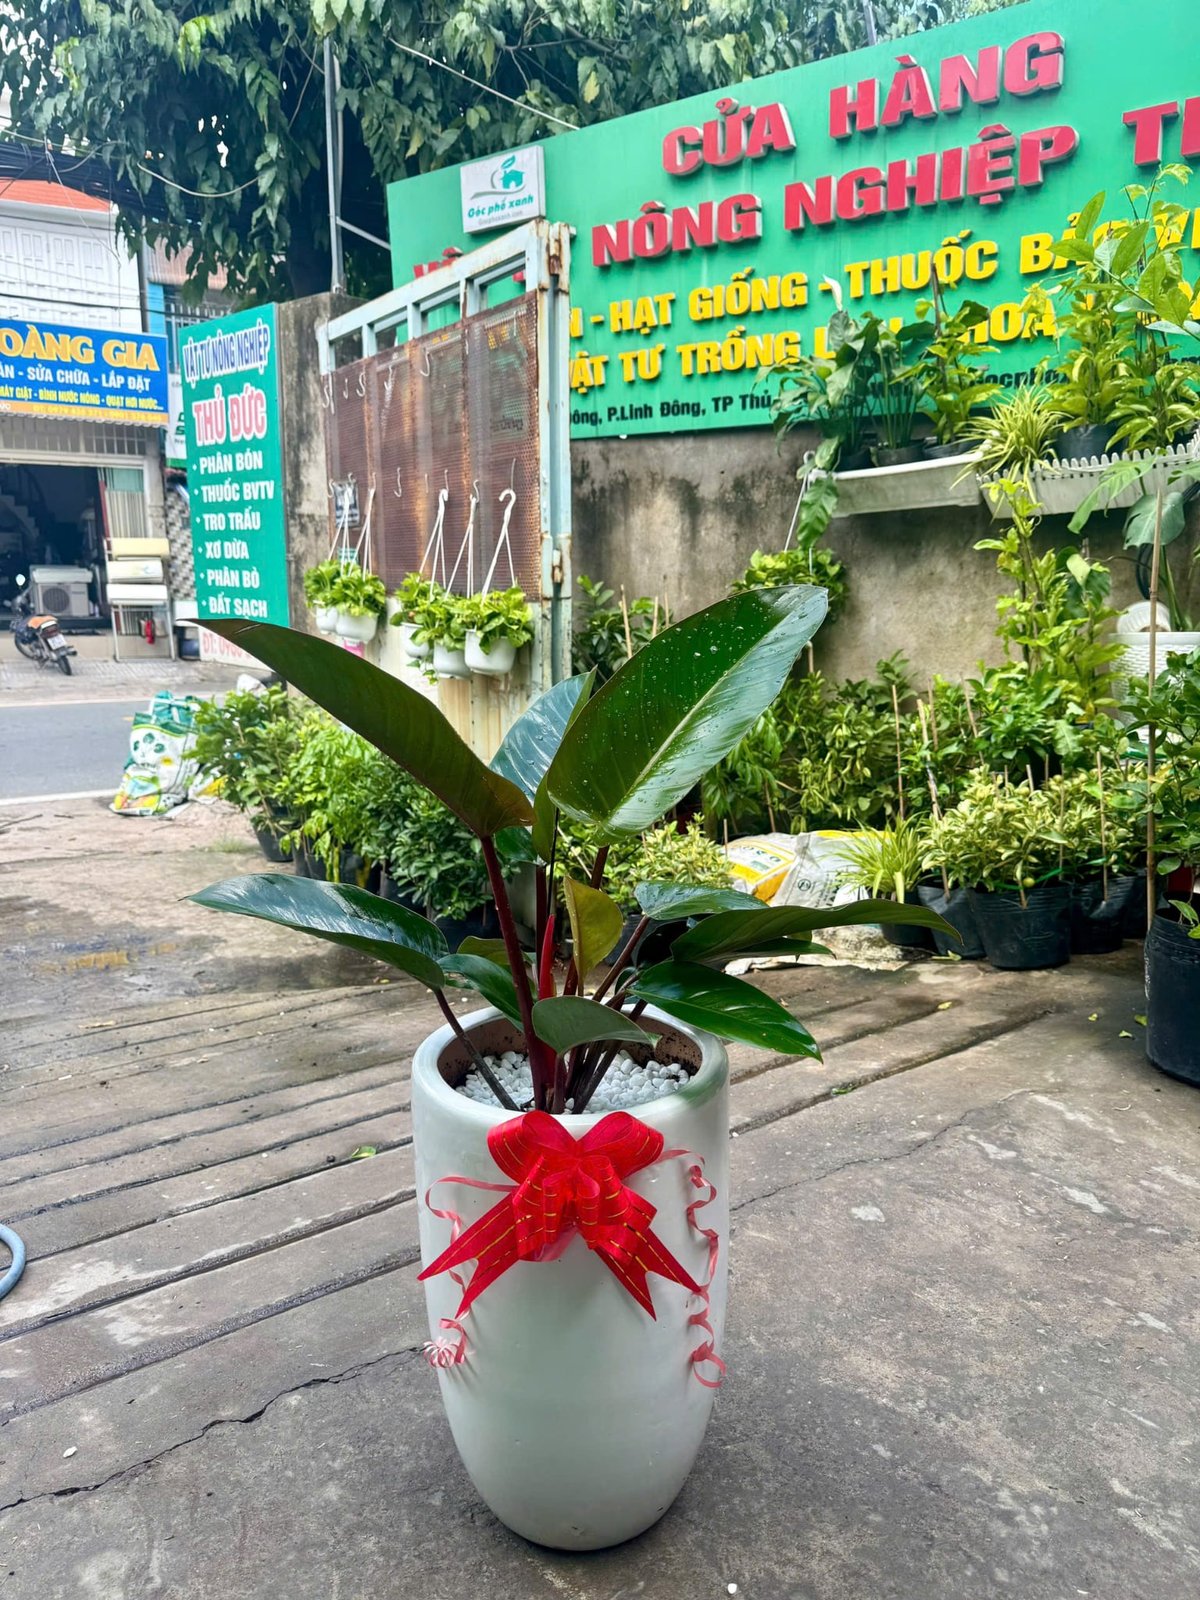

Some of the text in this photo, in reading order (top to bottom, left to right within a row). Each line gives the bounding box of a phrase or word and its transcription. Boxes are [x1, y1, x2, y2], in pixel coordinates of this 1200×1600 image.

[662, 31, 1065, 176] CỬA HÀNG
[508, 193, 534, 208] xanh
[592, 193, 762, 267] NÔNG
[784, 124, 1079, 230] NGHIỆP
[609, 292, 675, 335] HẠT
[688, 266, 808, 322] GIỐNG
[844, 229, 998, 298] THUỐC
[102, 339, 160, 371] GIA
[183, 337, 199, 389] VẬT
[211, 329, 235, 377] NÔNG
[236, 318, 270, 374] NGHIỆP
[569, 351, 608, 394] ẬT
[618, 344, 665, 382] TƯ
[676, 325, 801, 376] TRỒNG
[27, 363, 54, 382] SỬA
[192, 383, 267, 446] THỦ ĐỨC
[570, 409, 602, 426] ông,
[607, 404, 653, 421] P.Linh
[660, 400, 706, 417] Đông,
[712, 395, 733, 412] TP
[739, 389, 772, 410] Thủ
[200, 448, 263, 475] PHÂN BÓN
[201, 478, 274, 503] THUỐC BVTV
[203, 513, 228, 531] TRO
[205, 541, 222, 559] XƠ
[207, 568, 239, 587] PHÂN
